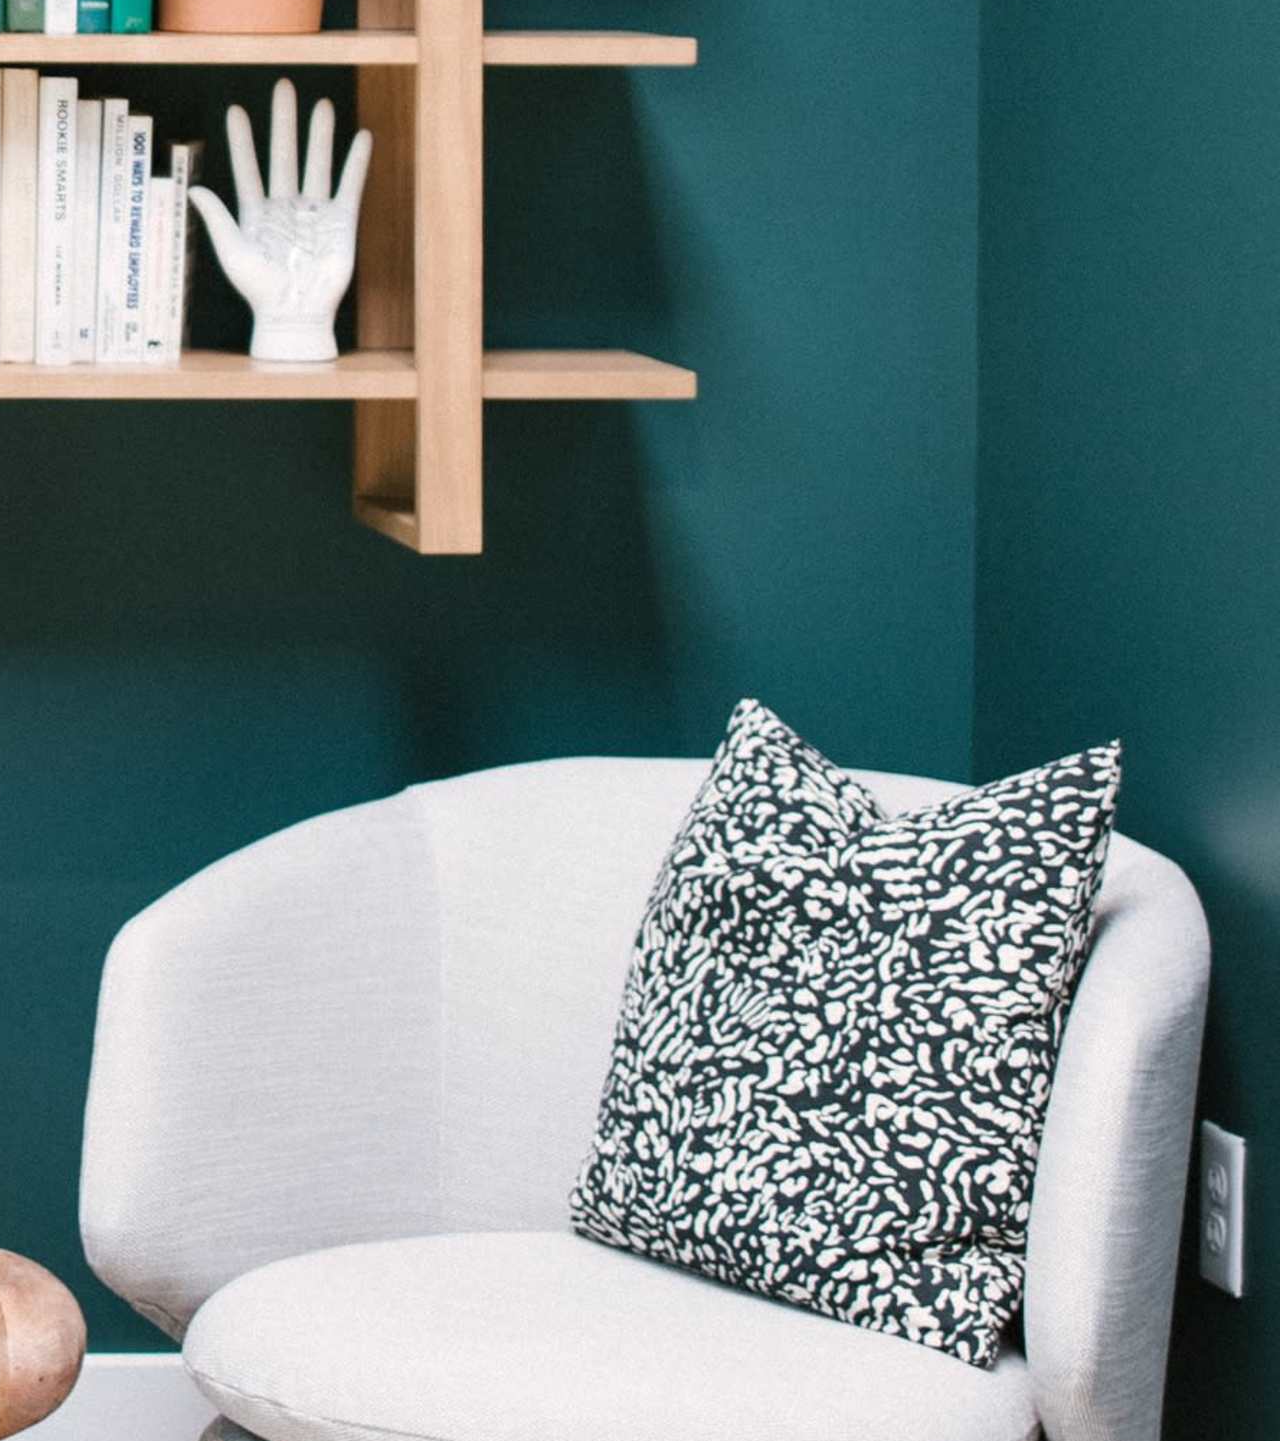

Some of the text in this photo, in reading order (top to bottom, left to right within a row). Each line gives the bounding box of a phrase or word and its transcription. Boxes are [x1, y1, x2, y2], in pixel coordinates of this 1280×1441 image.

[54, 99, 68, 221] ROOKIE SMARTS
[112, 113, 125, 224] MILLION DOLLAR
[126, 131, 146, 309] 1001 WAYS TO REWARD EMPLOYEES
